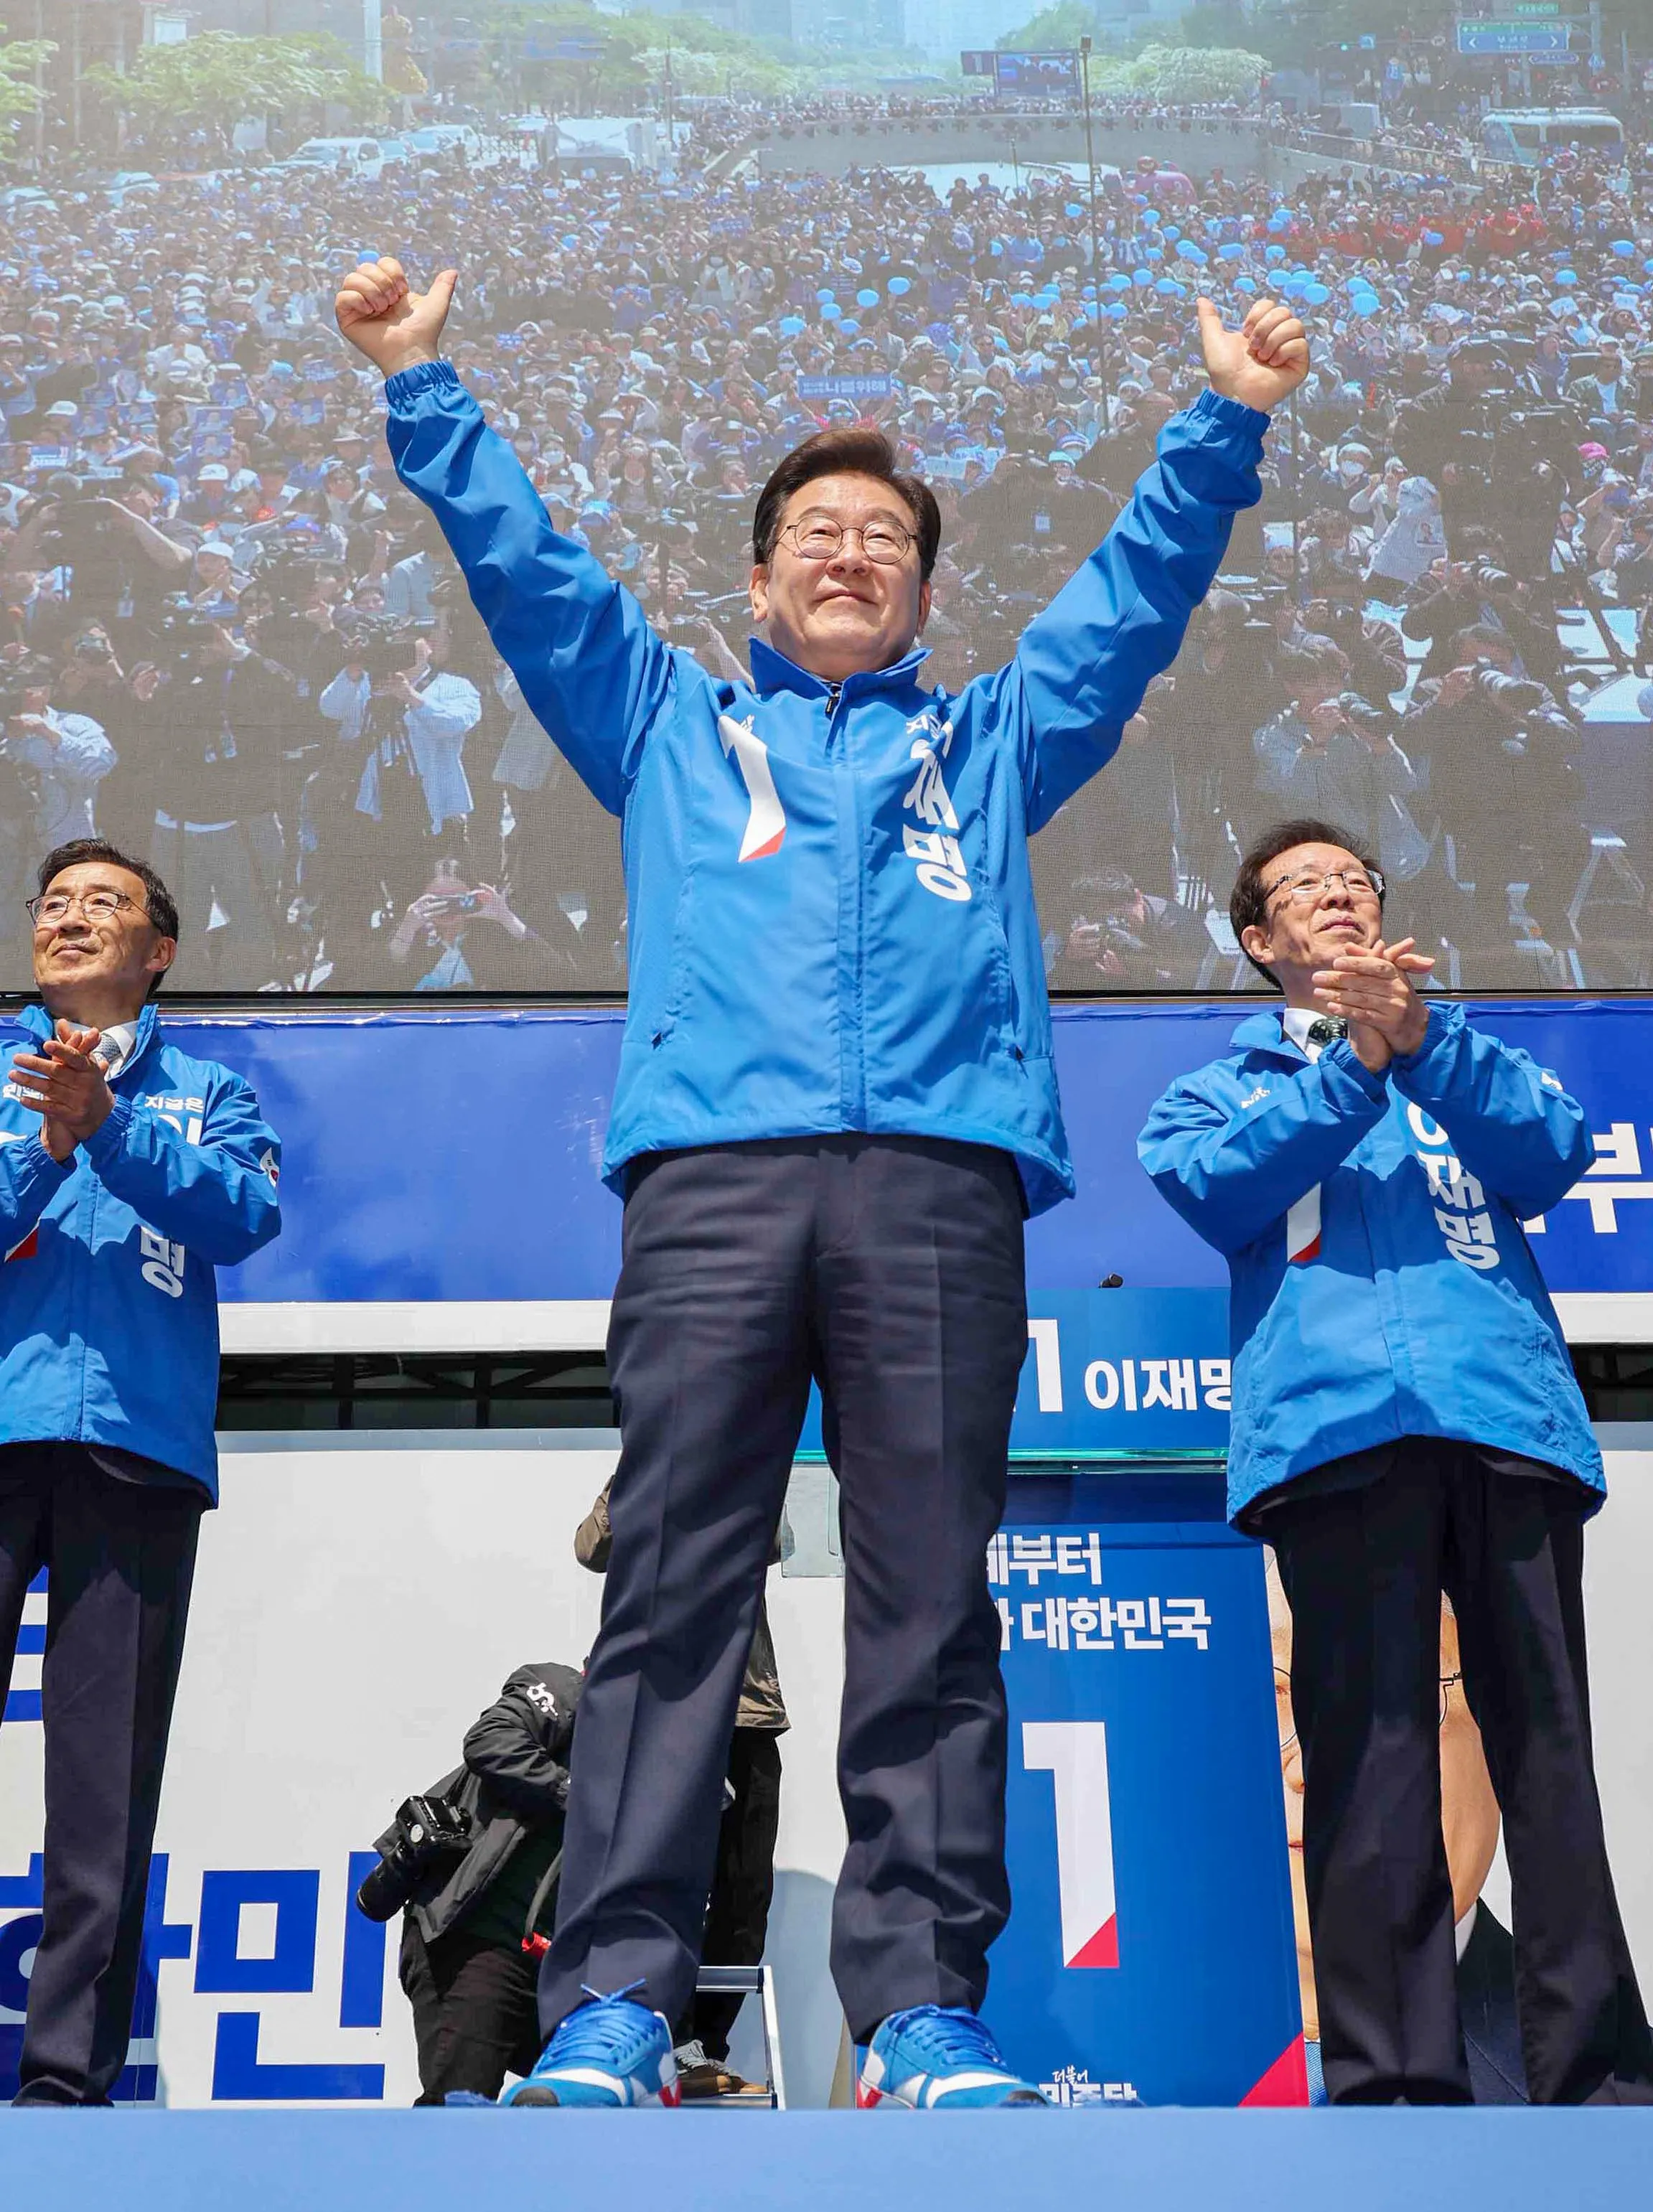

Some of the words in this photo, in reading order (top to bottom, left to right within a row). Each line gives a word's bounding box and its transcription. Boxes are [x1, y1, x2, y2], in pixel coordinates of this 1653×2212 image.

[718, 715, 787, 863] 1
[144, 1095, 204, 1113] 지금은
[1027, 1319, 1062, 1412] 1
[1021, 1597, 1212, 1650] 대한민국
[1022, 1722, 1120, 1968] 1
[1052, 2065, 1088, 2084] 더불어
